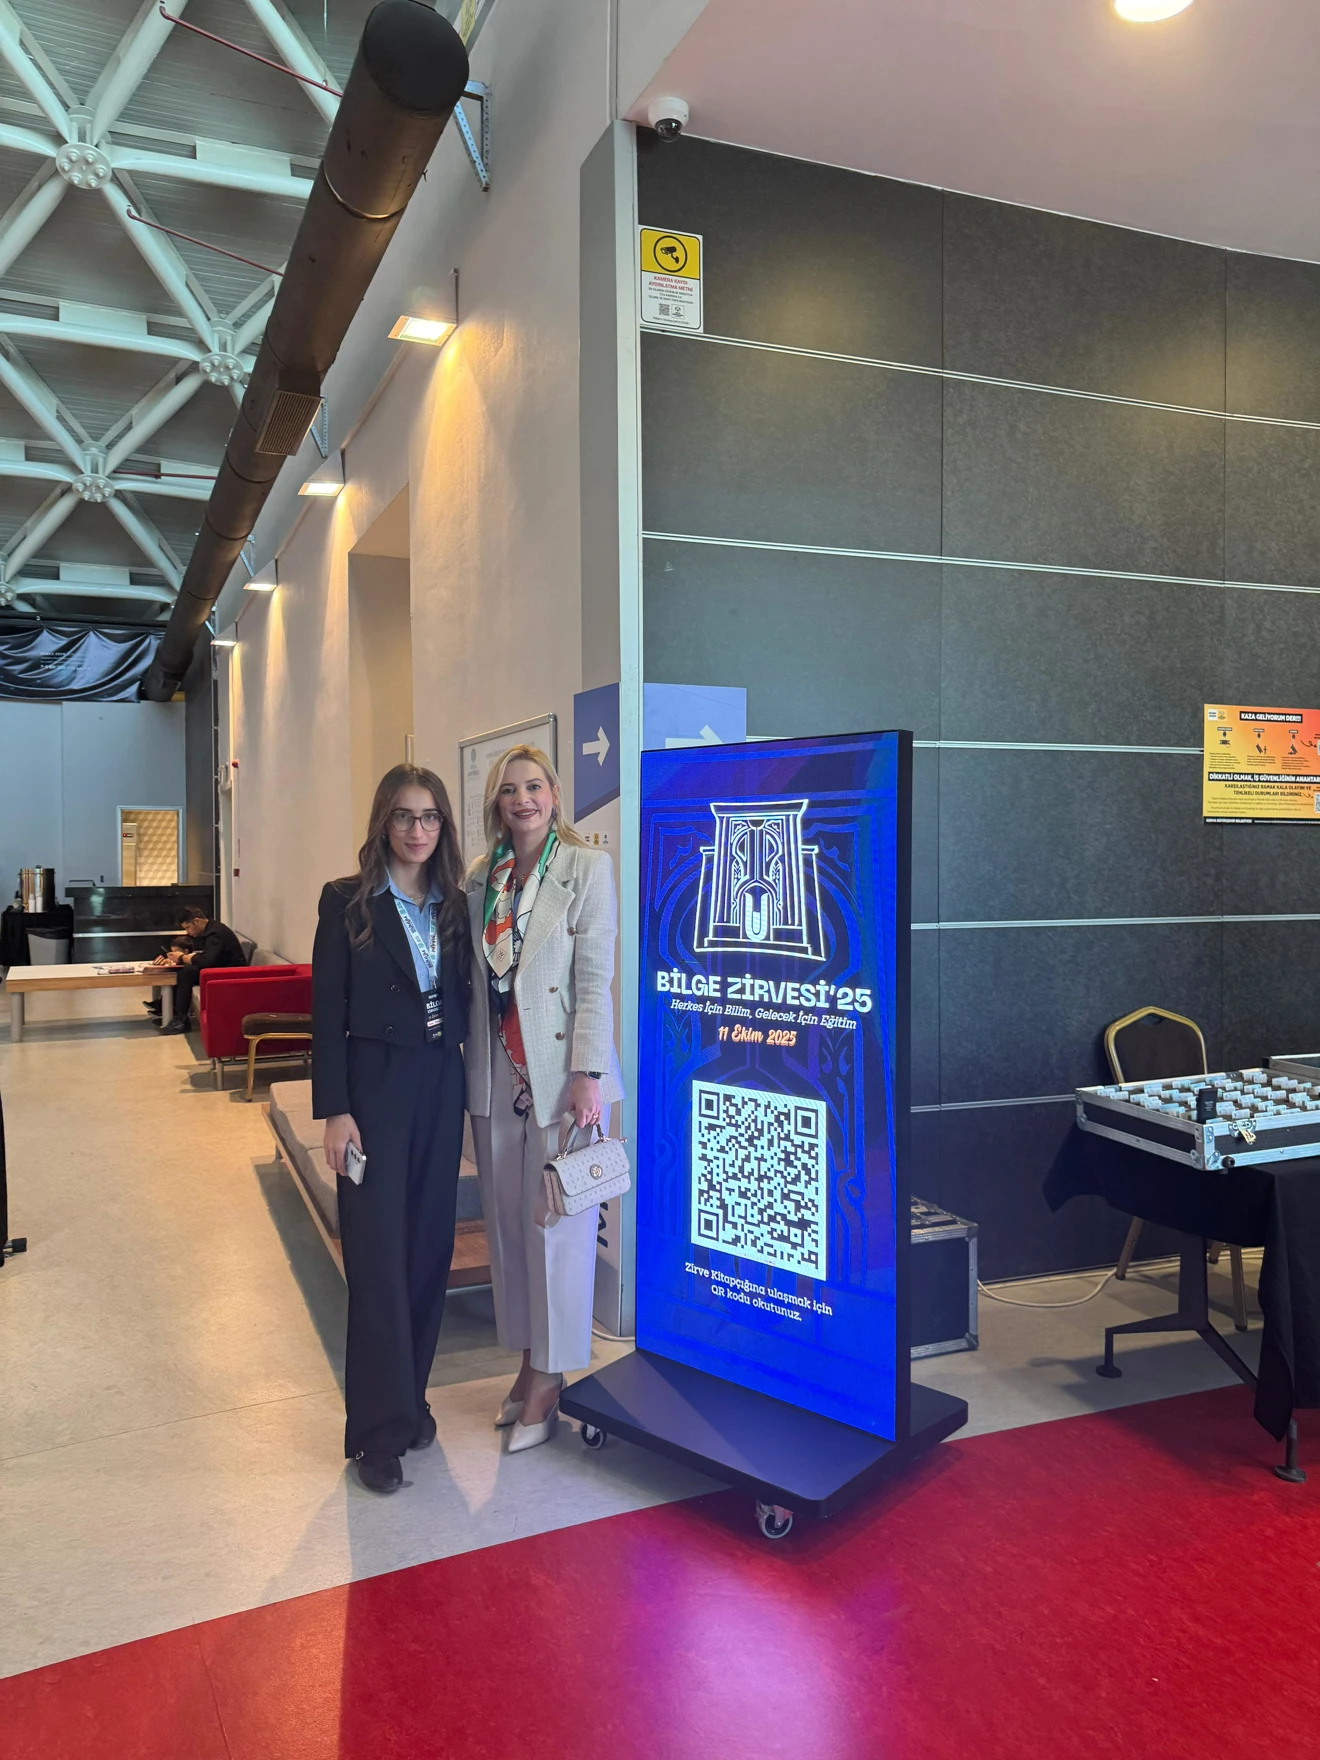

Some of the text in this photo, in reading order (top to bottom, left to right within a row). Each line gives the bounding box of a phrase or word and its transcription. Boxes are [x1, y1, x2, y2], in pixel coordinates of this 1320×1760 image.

[649, 281, 678, 290] AYDINLATMA
[1256, 713, 1286, 721] GELİYORUM
[1254, 774, 1259, 782] İŞ
[1259, 774, 1295, 782] GÜVENLİĞİNİN
[656, 967, 872, 1013] BİLGE ZİRVESİ'25
[670, 998, 857, 1030] Herkes İçin Bilim, Gelecek İçin Eğitim
[718, 1024, 797, 1047] 11 Ekim 2025
[685, 1261, 832, 1316] Zirve Kitapçığına ulaşmak için
[711, 1284, 802, 1321] QR kodu okutunuz.
